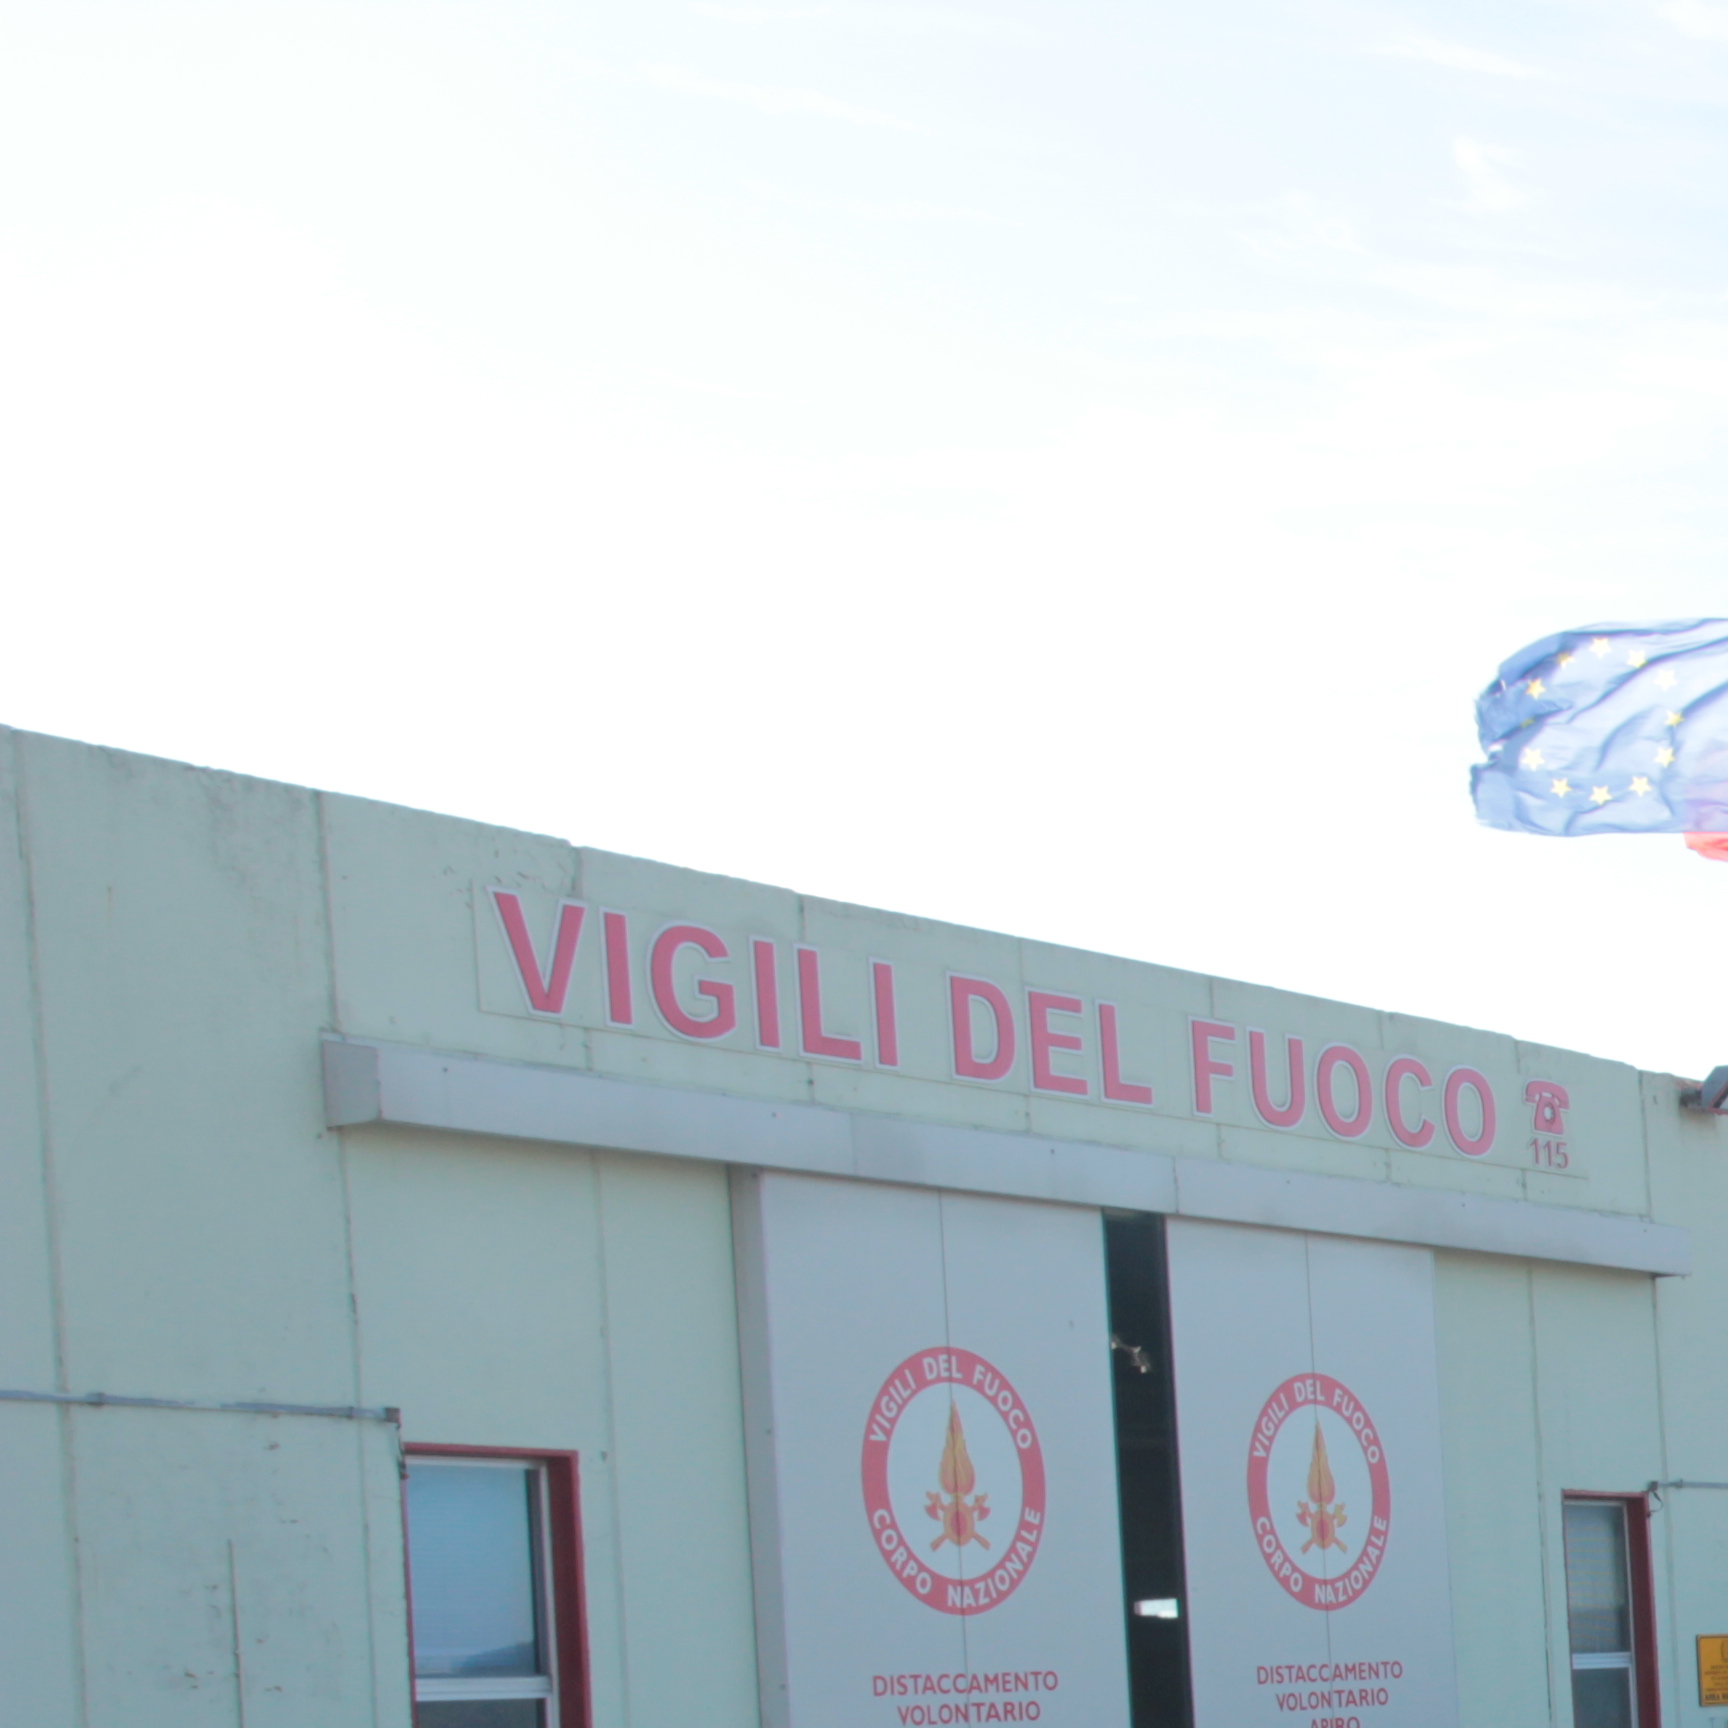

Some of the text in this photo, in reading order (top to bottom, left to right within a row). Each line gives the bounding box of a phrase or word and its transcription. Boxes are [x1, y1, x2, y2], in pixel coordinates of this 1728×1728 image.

[493, 889, 1497, 1157] VIGILI DEL FUOCO
[1530, 1138, 1569, 1169] 115
[869, 1354, 1033, 1449] VIGILI DEL FUOCO
[1253, 1379, 1381, 1464] VIGILI DEL FUOCO
[873, 1507, 1041, 1608] CORPO NAZIONALE
[1256, 1515, 1387, 1604] CORPO NAZIONALE
[872, 1670, 1059, 1697] DISTACCAMENTO
[1256, 1660, 1403, 1685] DISTACCAMENTO
[1275, 1687, 1389, 1712] VOLONTARIO
[897, 1701, 1041, 1726] VOLONTARIO
